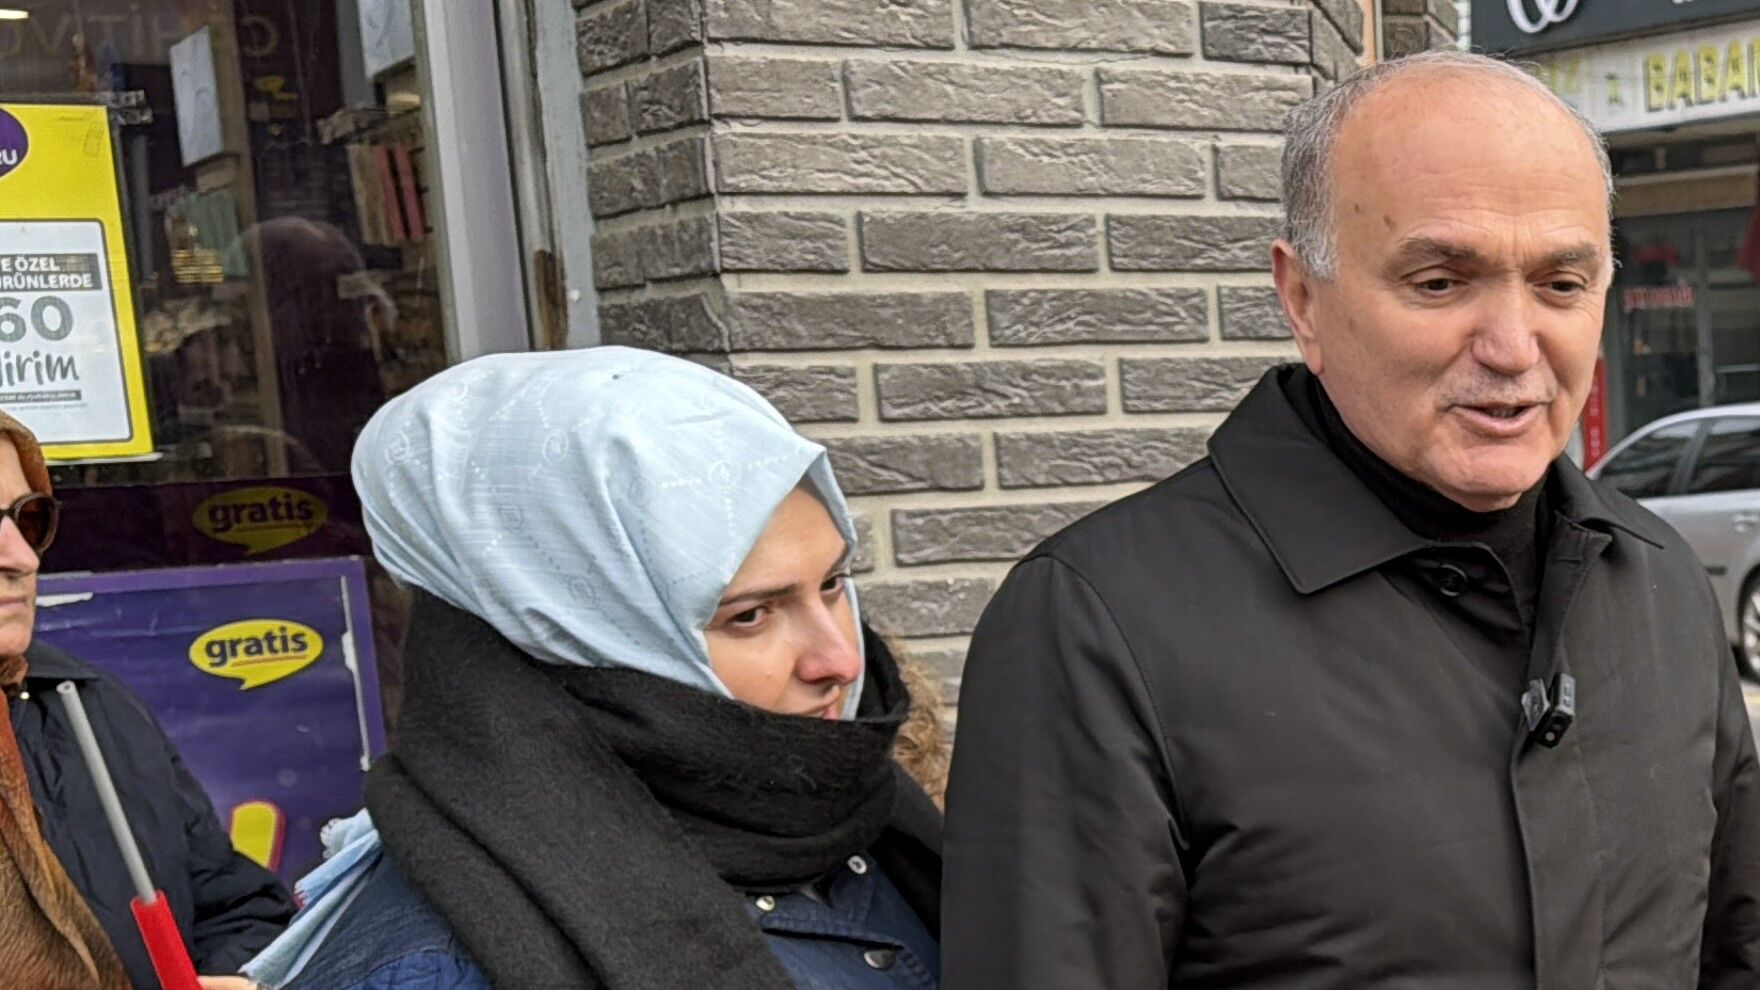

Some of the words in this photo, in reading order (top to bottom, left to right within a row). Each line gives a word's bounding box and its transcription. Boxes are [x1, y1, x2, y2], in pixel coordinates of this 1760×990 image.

[0, 272, 93, 290] RÜNLERDE
[14, 255, 61, 272] ÖZEL
[0, 350, 80, 386] irim
[208, 493, 314, 532] gratis
[205, 626, 309, 668] gratis
